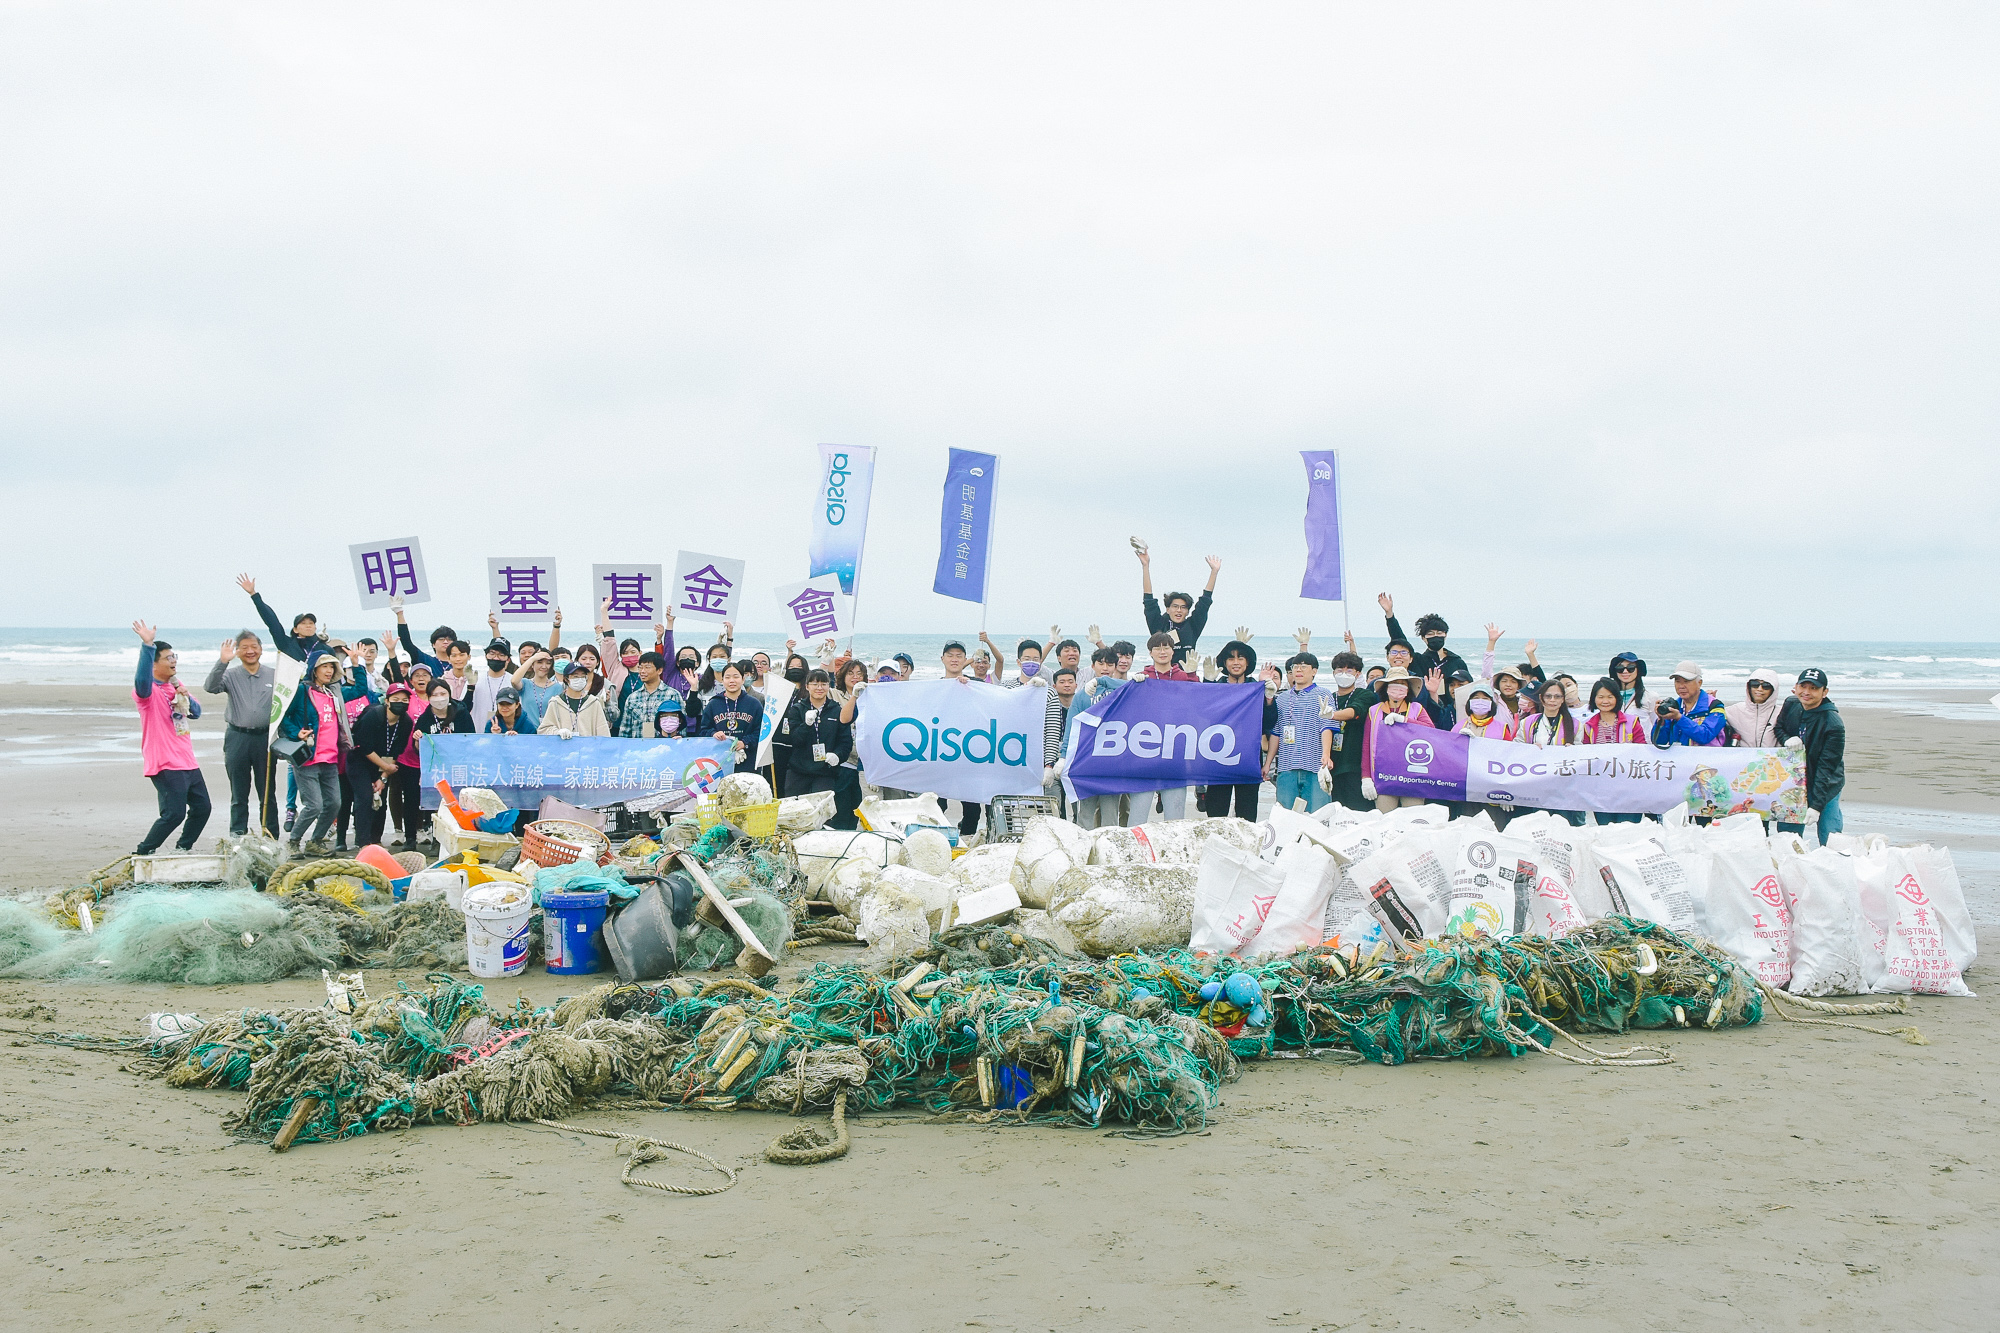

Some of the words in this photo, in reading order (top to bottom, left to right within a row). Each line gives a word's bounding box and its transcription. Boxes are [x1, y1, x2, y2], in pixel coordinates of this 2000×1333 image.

[361, 545, 419, 598] 明
[498, 565, 549, 614] 基
[680, 563, 733, 616] 金
[602, 572, 654, 621] 基
[786, 586, 839, 639] 會
[881, 716, 1028, 767] Qisda
[1091, 720, 1242, 766] BenQ
[430, 763, 677, 791] 社團法人海線一家親環保協會
[1378, 772, 1398, 782] Digital
[1398, 775, 1436, 786] Opportunity
[1436, 779, 1458, 788] Center
[1487, 760, 1548, 777] DOC
[1553, 756, 1677, 781] 志工小旅行
[1888, 967, 1899, 975] DO
[1899, 968, 1914, 978] NOT
[1915, 970, 1930, 979] ADD
[1931, 972, 1938, 980] IN
[1921, 949, 1935, 957] NOT
